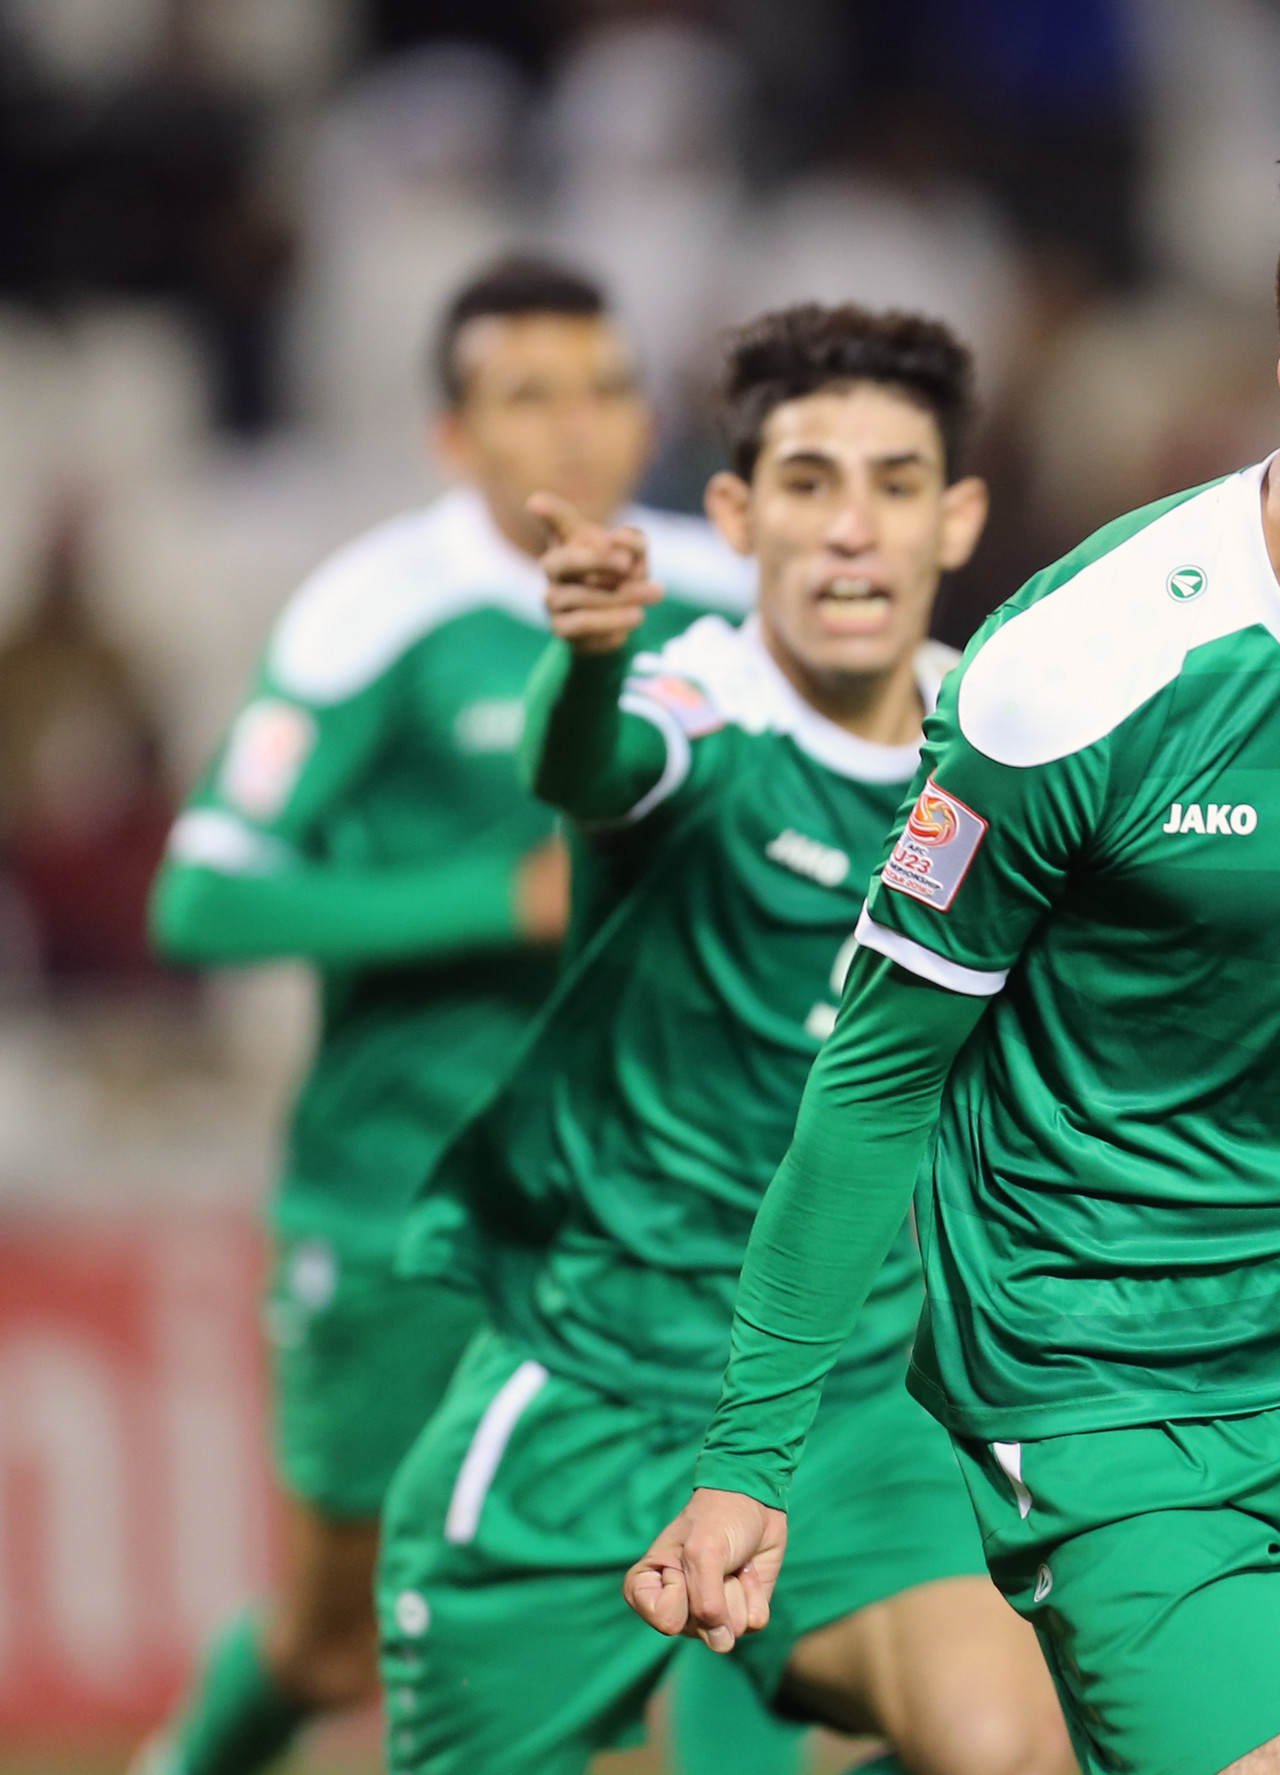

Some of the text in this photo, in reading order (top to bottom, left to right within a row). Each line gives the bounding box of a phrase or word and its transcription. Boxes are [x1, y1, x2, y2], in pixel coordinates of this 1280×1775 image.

[1163, 803, 1258, 836] JAKO
[893, 844, 931, 875] U23
[908, 843, 928, 856] AFC
[890, 863, 940, 889] MPIONSHIP
